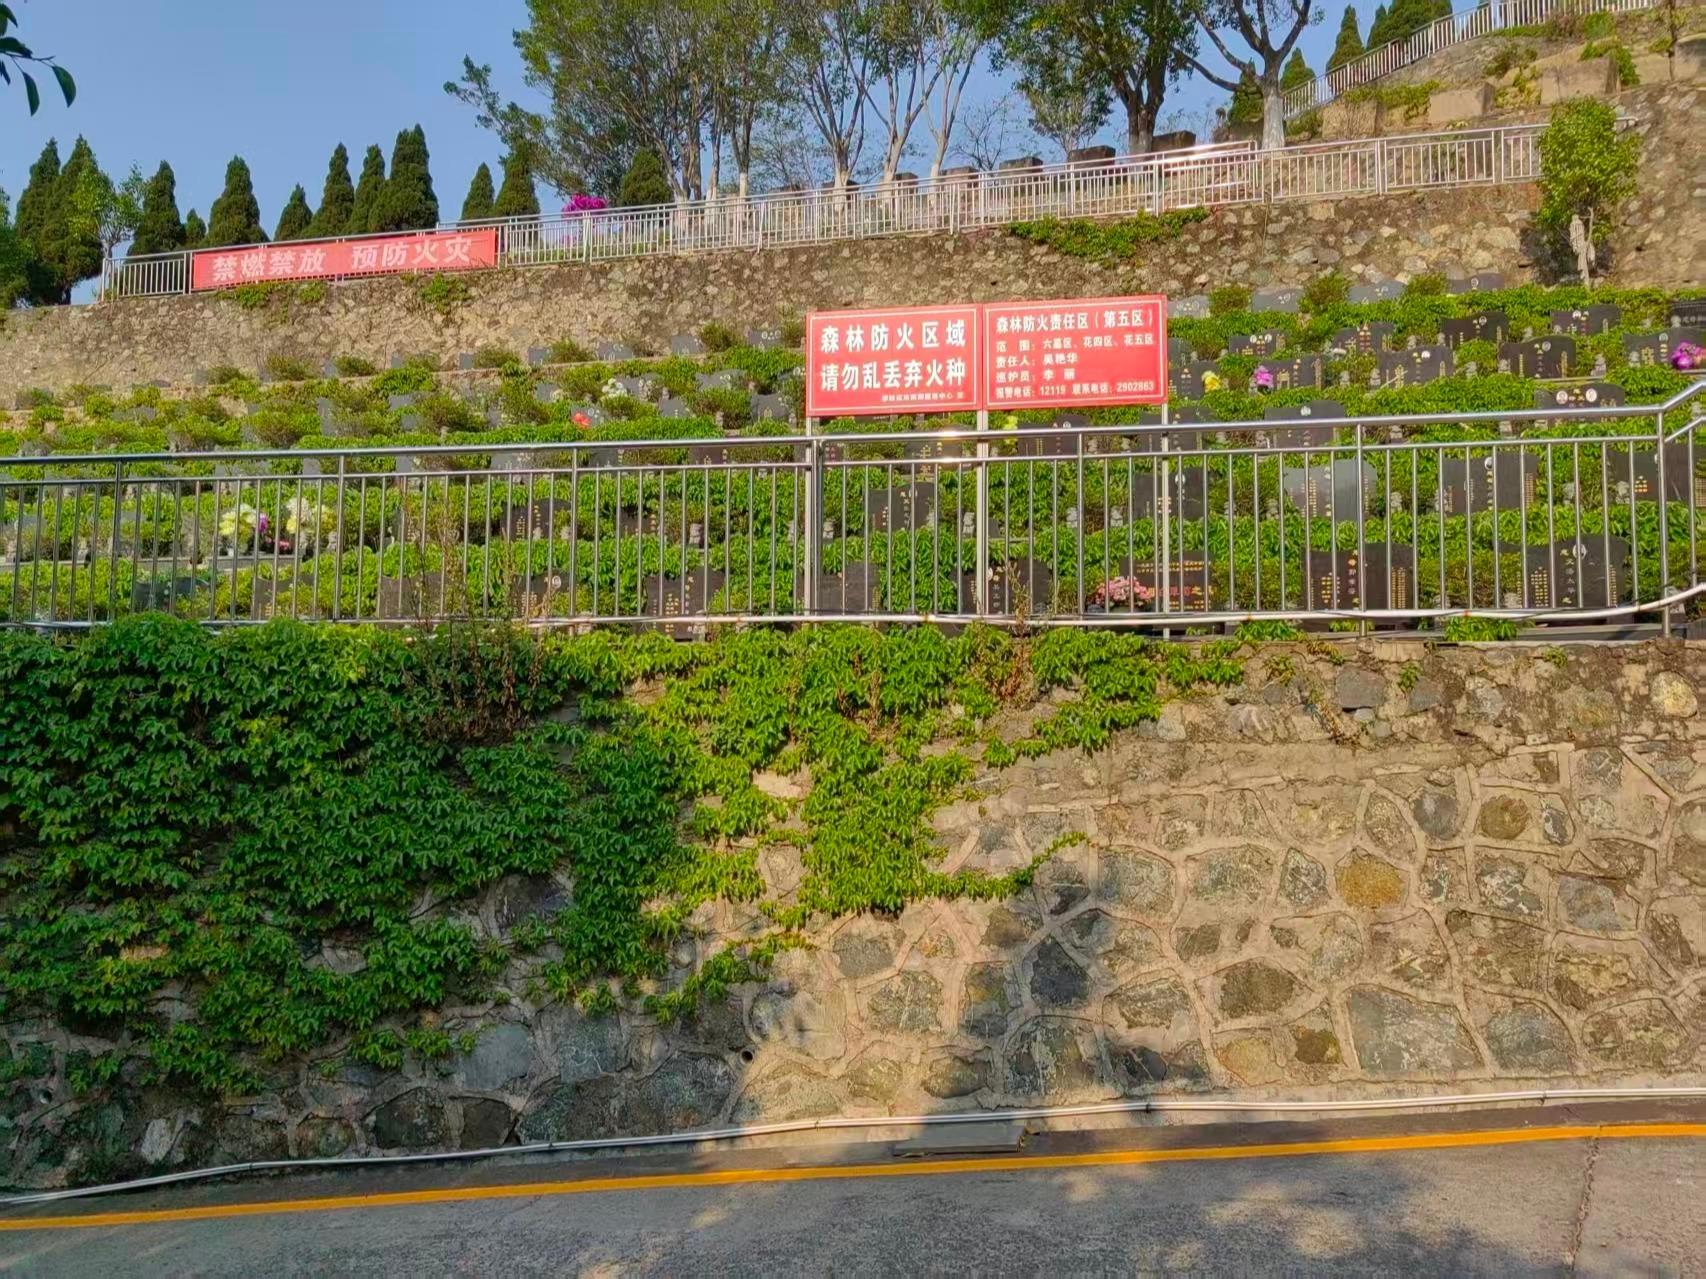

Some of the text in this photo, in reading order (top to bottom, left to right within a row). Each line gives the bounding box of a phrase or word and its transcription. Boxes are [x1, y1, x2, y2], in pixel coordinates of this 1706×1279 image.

[212, 236, 473, 282] 禁燃禁放 预防火灾
[820, 319, 966, 353] 森林防火区域
[820, 357, 966, 391] 请勿乱丢弃火种
[1040, 384, 1066, 396] 12119
